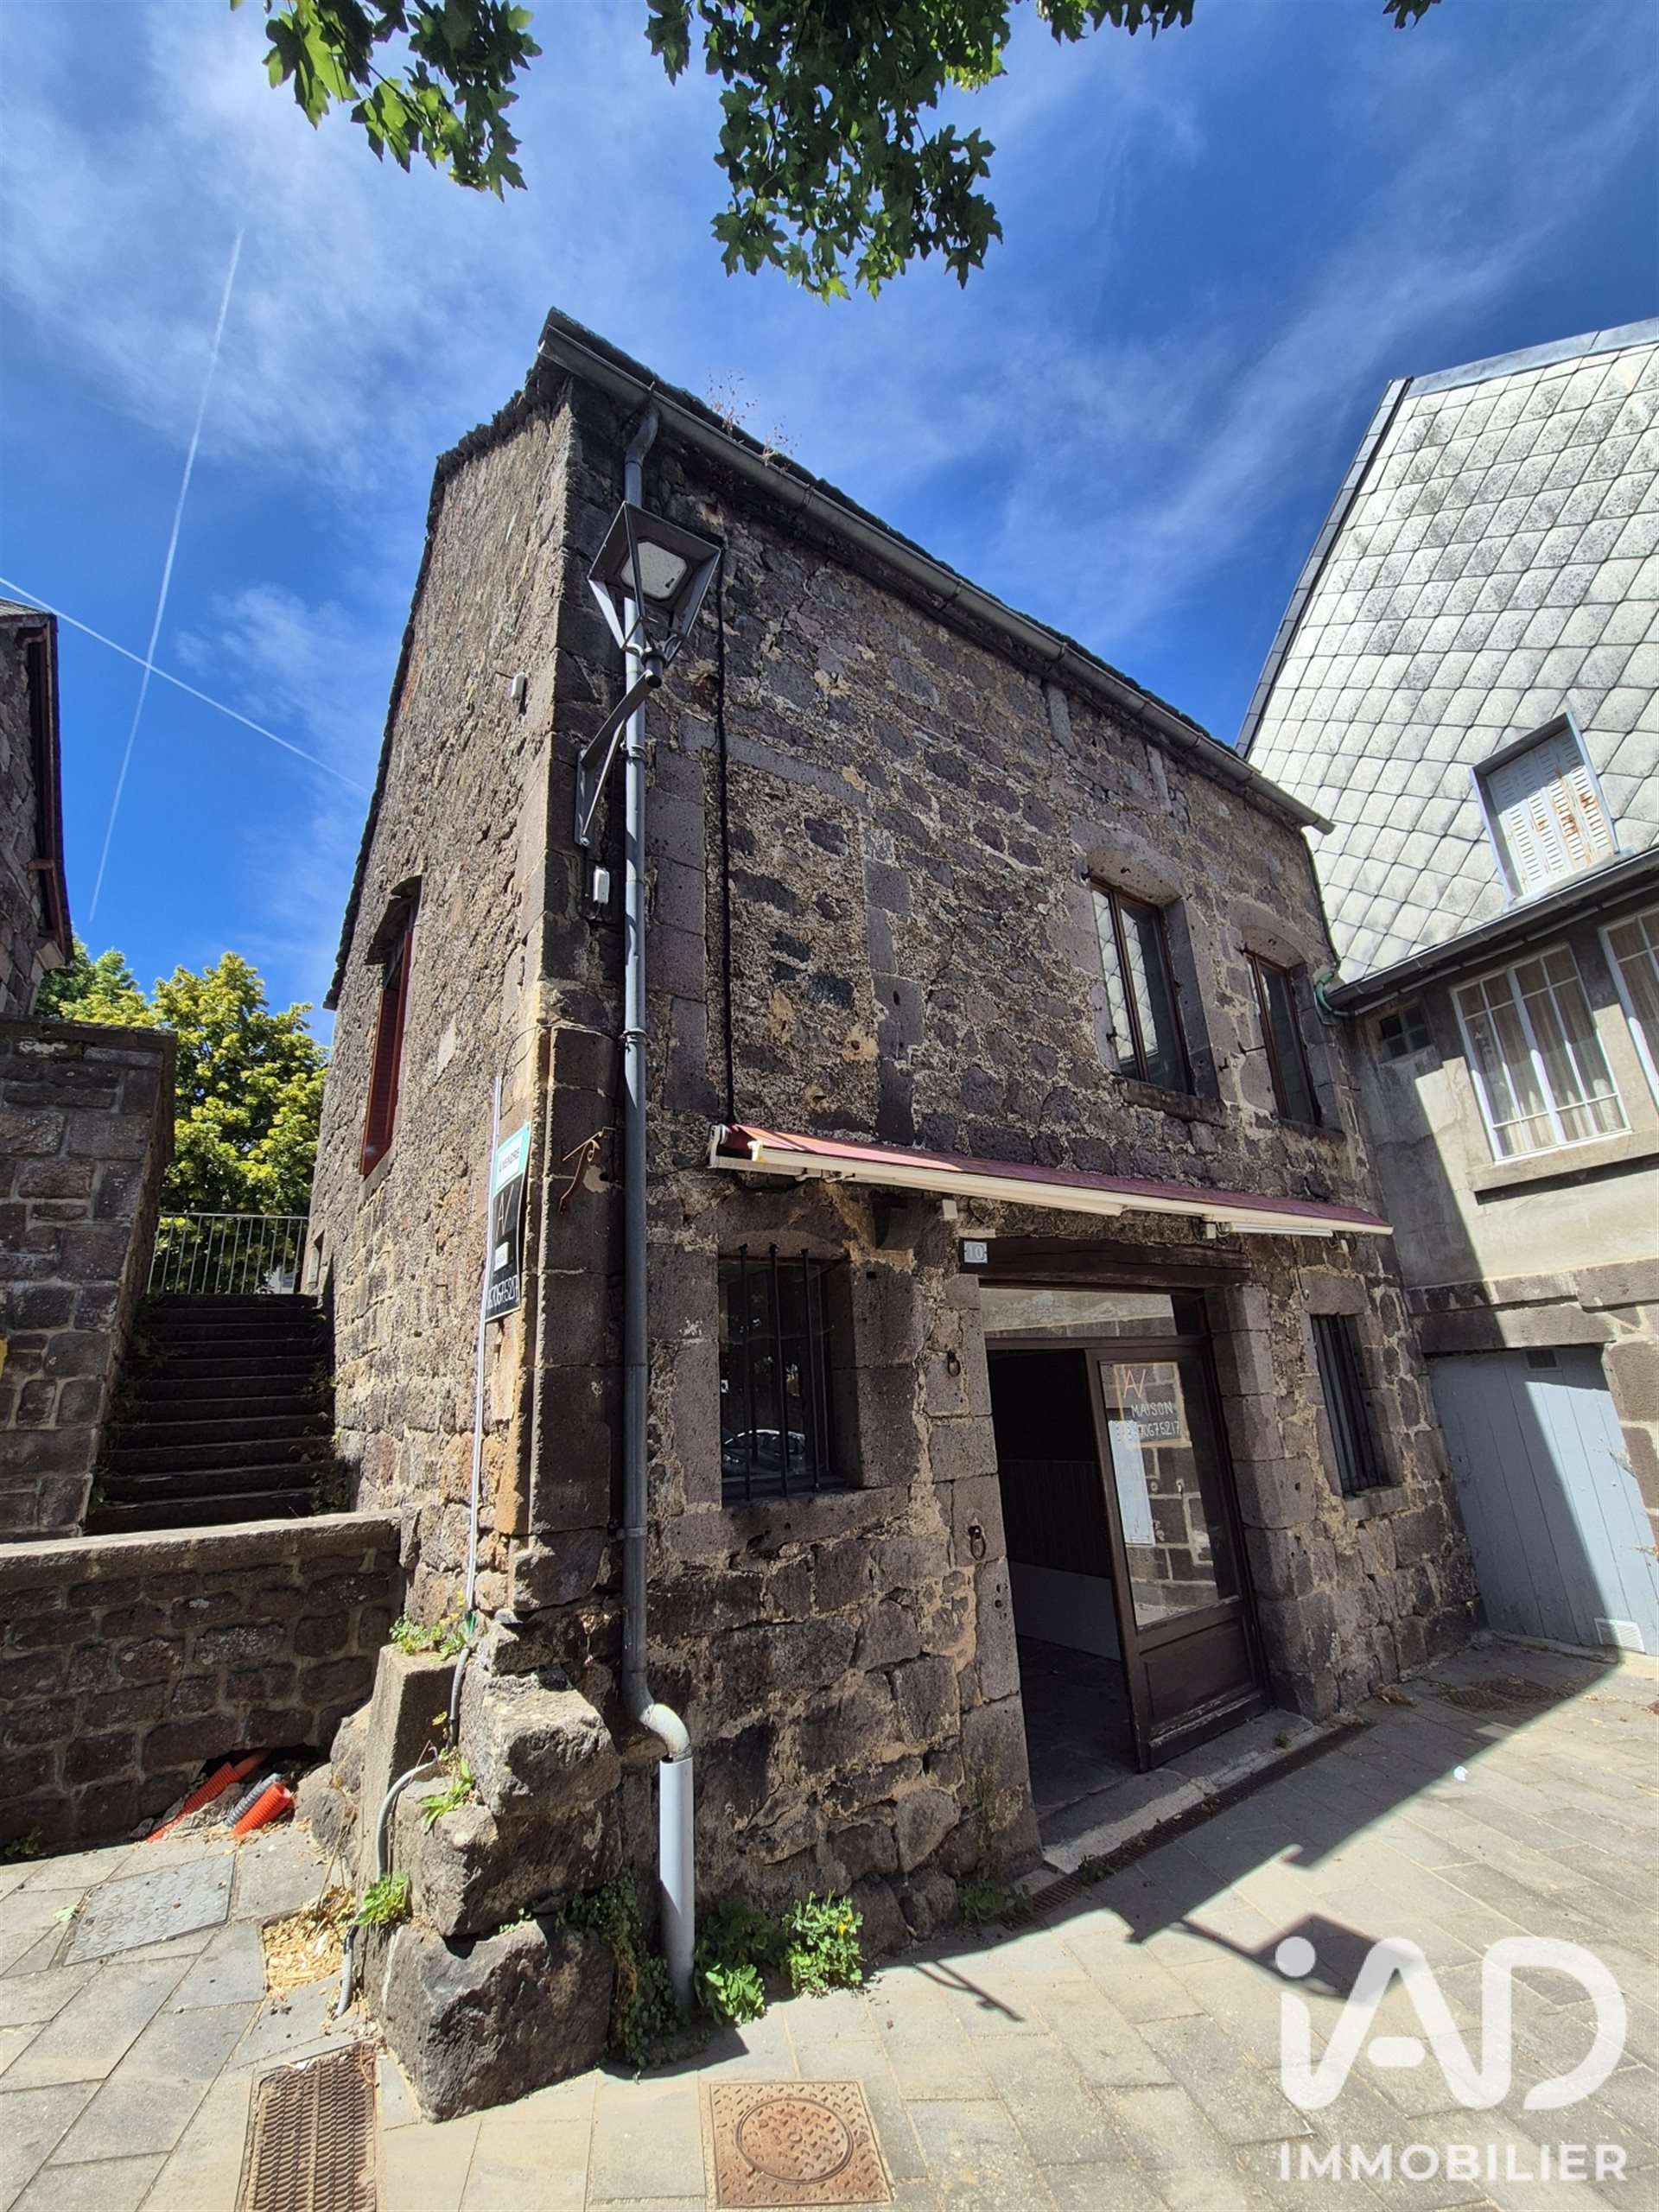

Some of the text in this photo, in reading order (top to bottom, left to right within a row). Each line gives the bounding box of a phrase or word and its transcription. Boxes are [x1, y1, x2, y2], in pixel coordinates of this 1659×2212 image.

[502, 1147, 521, 1170] VENDRE
[969, 1245, 983, 1260] 10
[1130, 1401, 1173, 1418] MAISON
